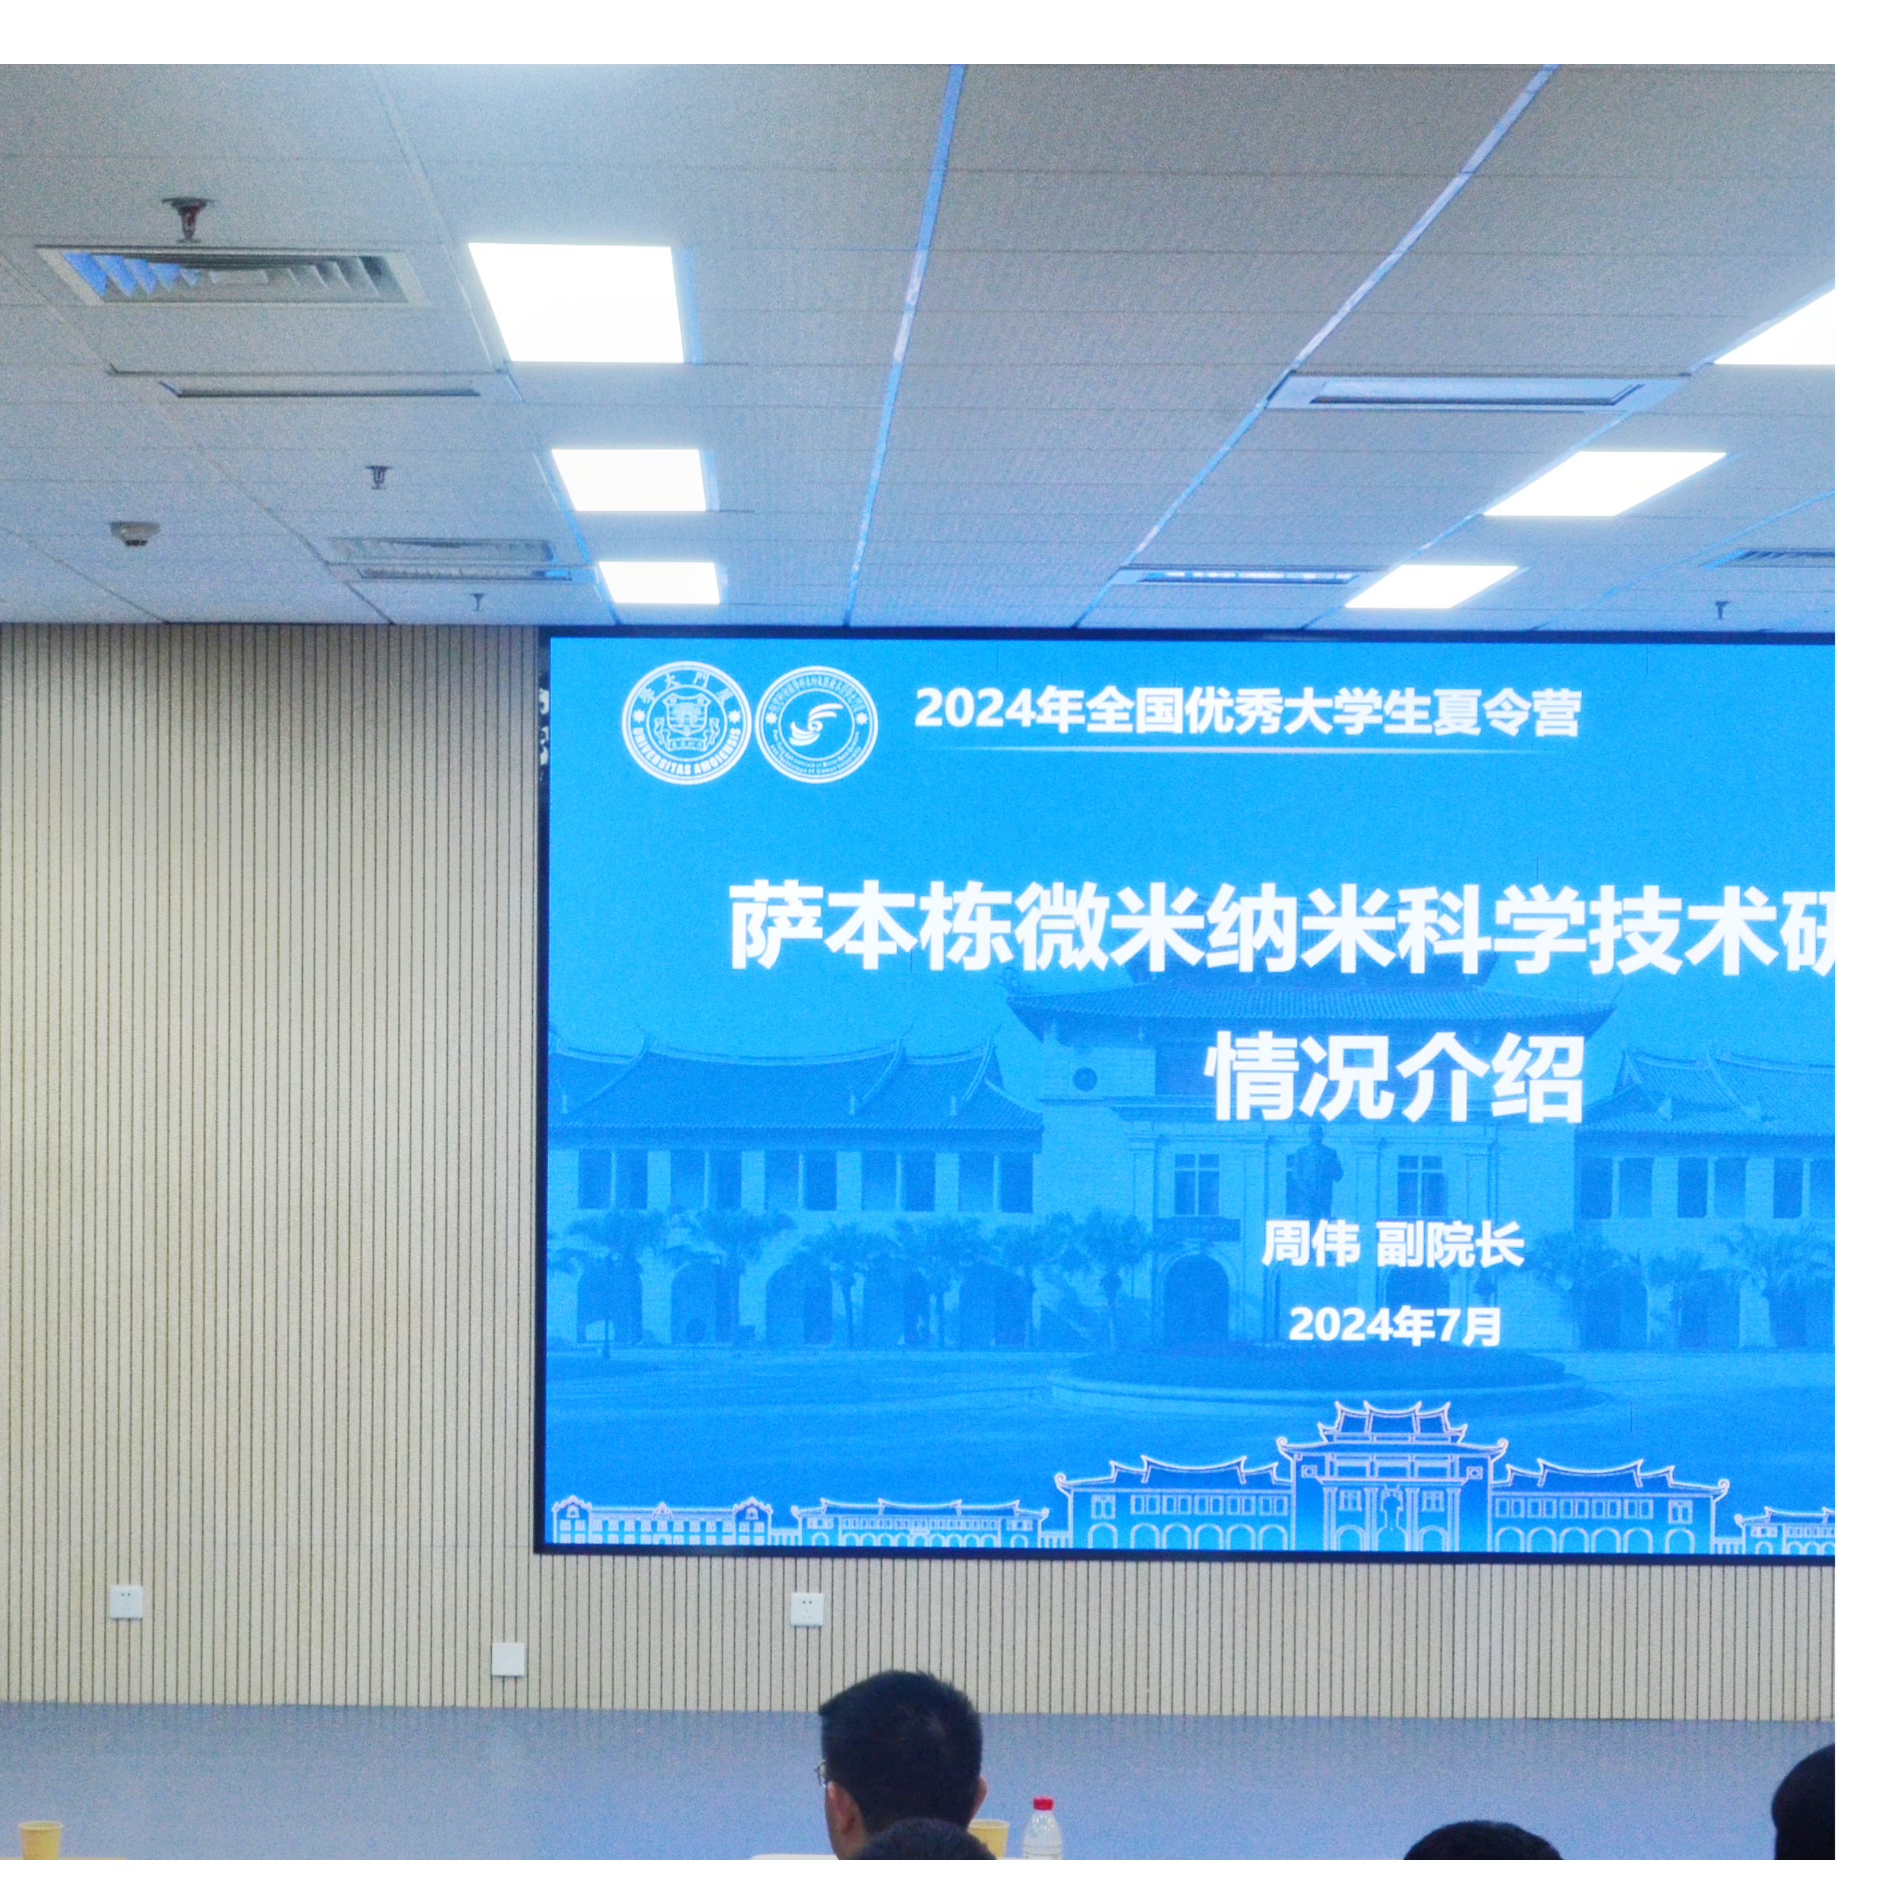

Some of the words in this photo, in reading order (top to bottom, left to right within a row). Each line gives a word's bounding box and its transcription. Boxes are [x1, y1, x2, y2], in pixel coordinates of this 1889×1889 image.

[914, 685, 1583, 738] 2024年全国优秀大学生夏令营
[632, 726, 693, 776] UNIVERSITAS
[694, 726, 742, 775] AMOIENSIS
[1204, 1030, 1585, 1124] 情况介绍
[1261, 1219, 1361, 1268] 周伟
[1376, 1219, 1525, 1268] 副院长
[1289, 1305, 1501, 1348] 2024年7月
